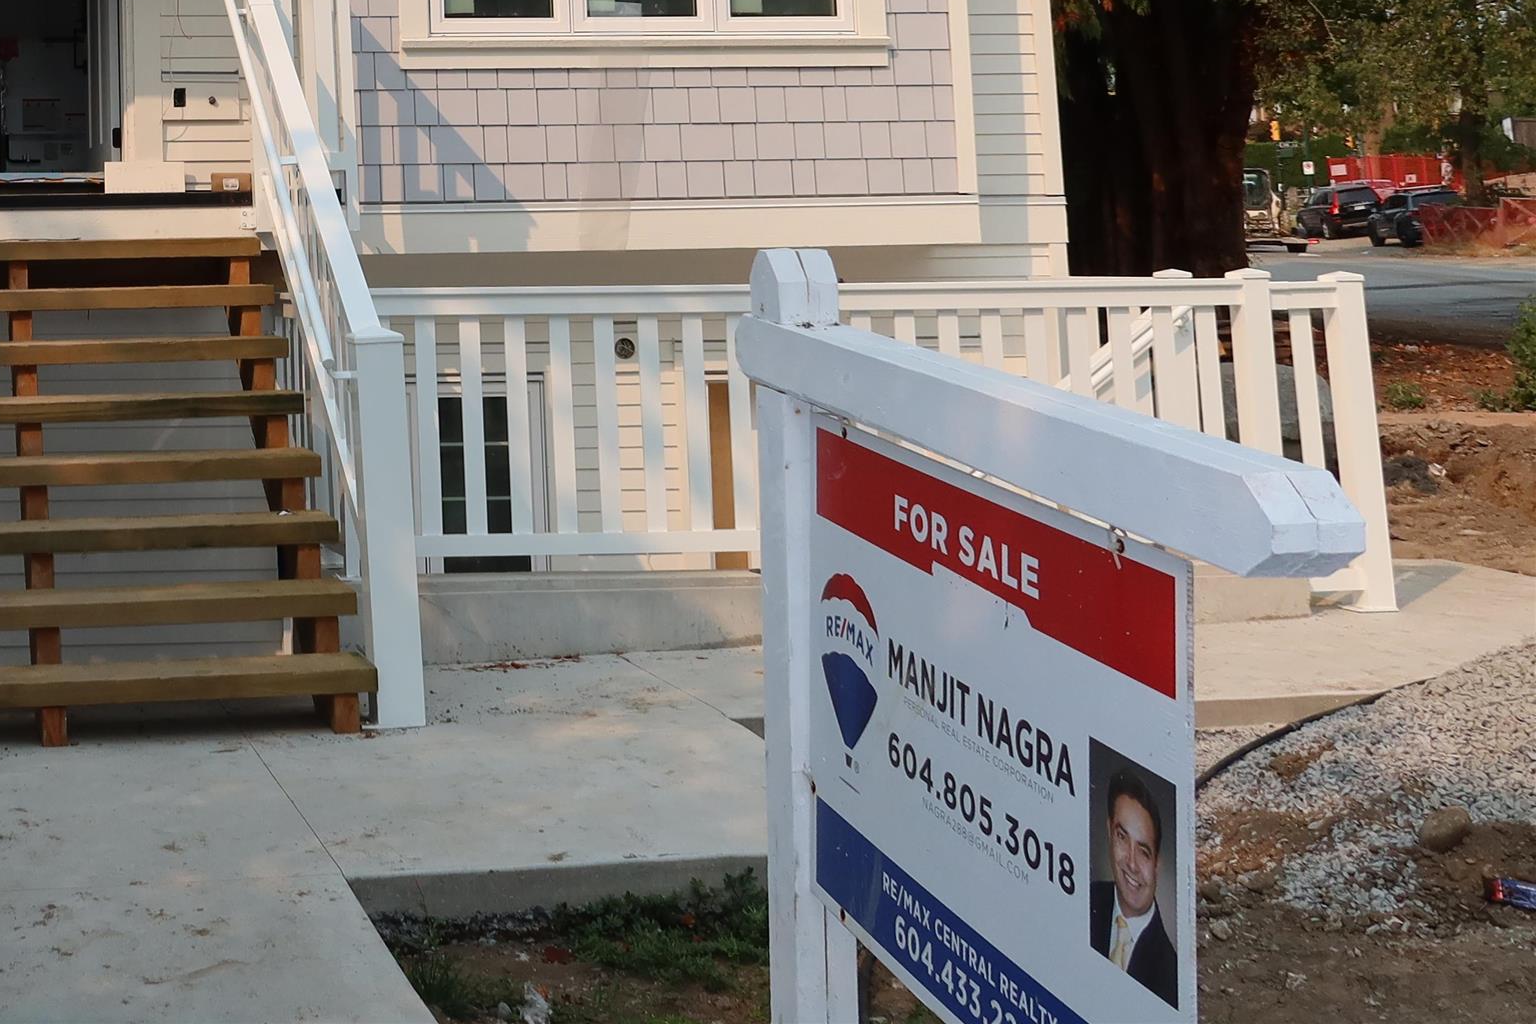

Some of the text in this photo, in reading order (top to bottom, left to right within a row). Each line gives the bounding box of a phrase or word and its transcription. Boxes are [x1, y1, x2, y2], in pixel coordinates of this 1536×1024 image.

[894, 494, 1040, 600] FOR SALE
[826, 615, 874, 668] RE/MAX
[888, 637, 1076, 798] MANJIT NAGRA
[903, 696, 1054, 804] PERSONAL REAL ESTATE CORPORATION
[888, 732, 1075, 896] 604.805.3018
[882, 871, 931, 931] RE/MAX
[934, 918, 995, 988] CENTRAL
[894, 913, 1017, 1024] 604.433.2
